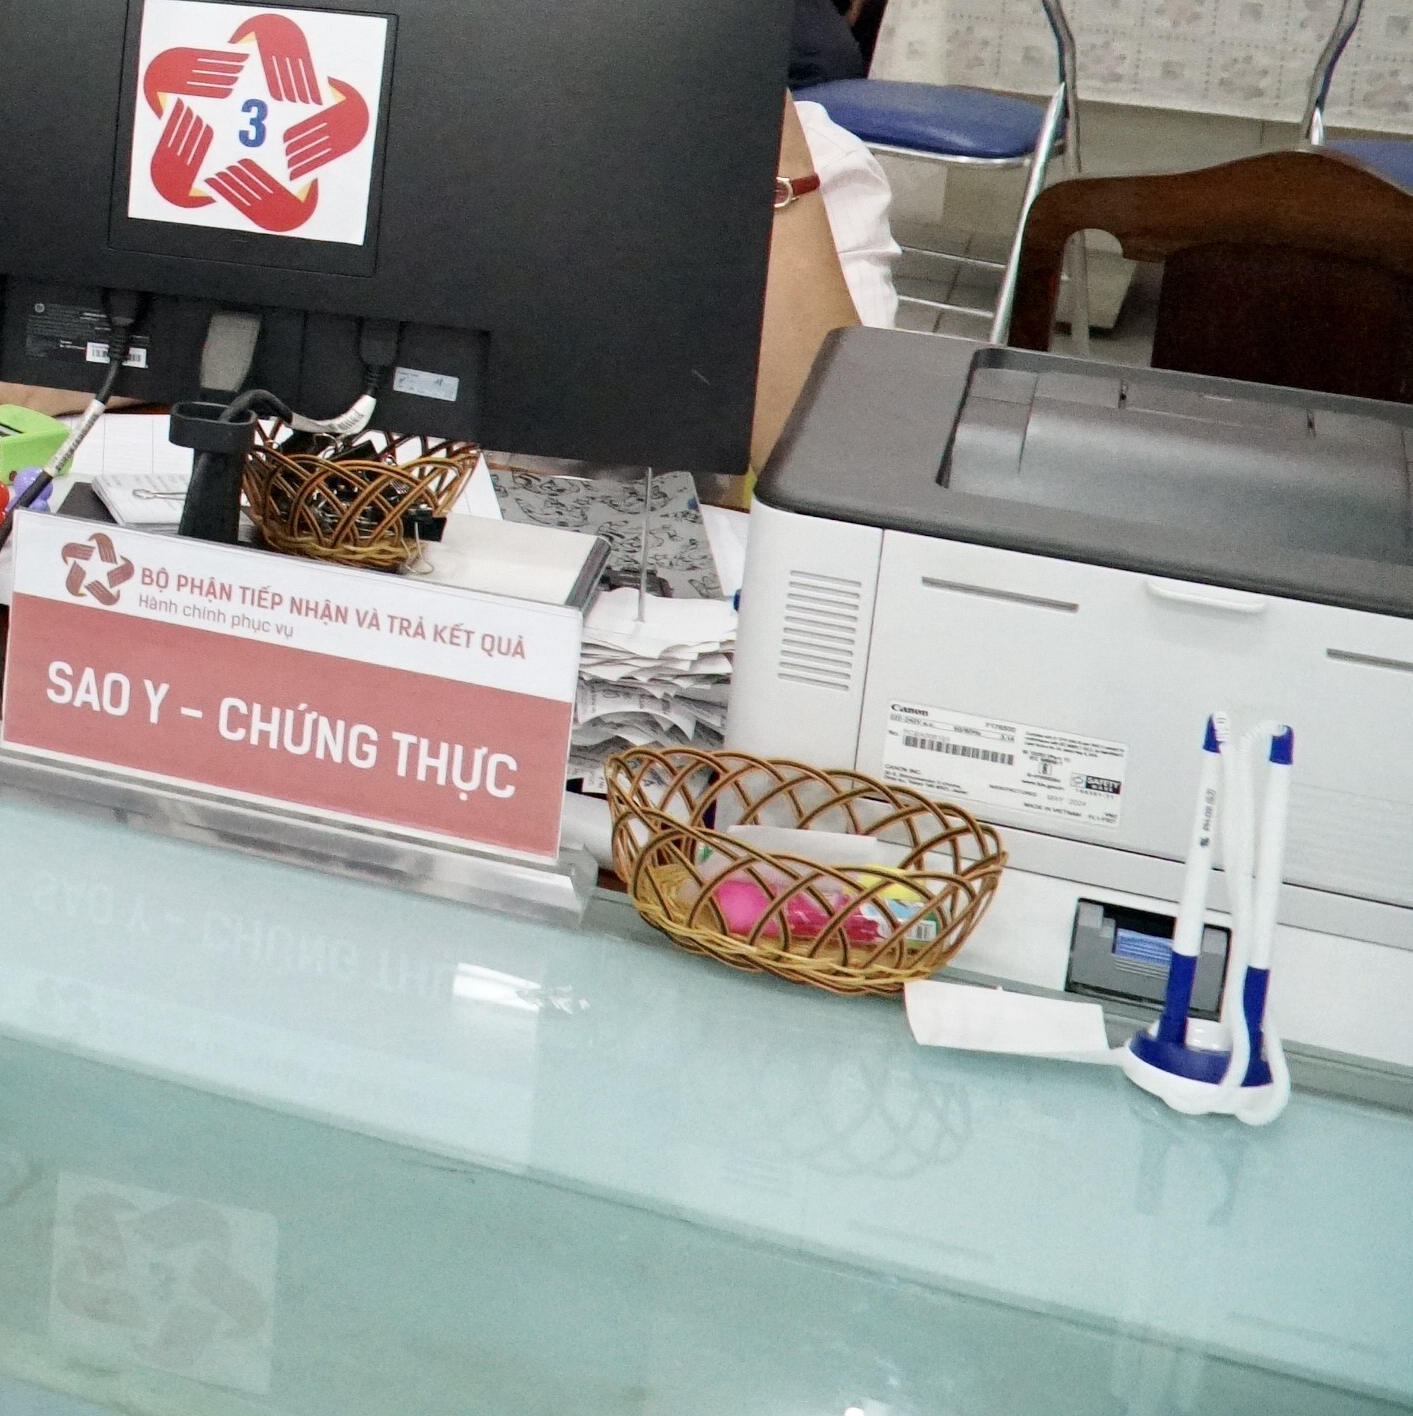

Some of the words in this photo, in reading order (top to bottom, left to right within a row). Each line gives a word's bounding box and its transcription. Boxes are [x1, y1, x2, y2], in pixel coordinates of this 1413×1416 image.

[238, 97, 269, 149] 3
[139, 594, 178, 615] Hành
[183, 602, 226, 624] chính
[231, 612, 271, 634] phục
[276, 622, 294, 639] vụ
[141, 567, 168, 590] BỘ
[177, 574, 232, 602] PHẬN
[239, 585, 283, 610] TIẾP
[290, 598, 348, 625] NHẬN
[355, 608, 380, 630] VÀ
[387, 615, 426, 640] TRẢ
[434, 623, 474, 648] KẾT
[481, 634, 526, 660] QUẢ
[46, 660, 131, 717] SAO
[143, 679, 170, 724] Y
[219, 698, 378, 770] CHỨNG
[392, 732, 518, 801] THỰC
[891, 703, 929, 717] Canon
